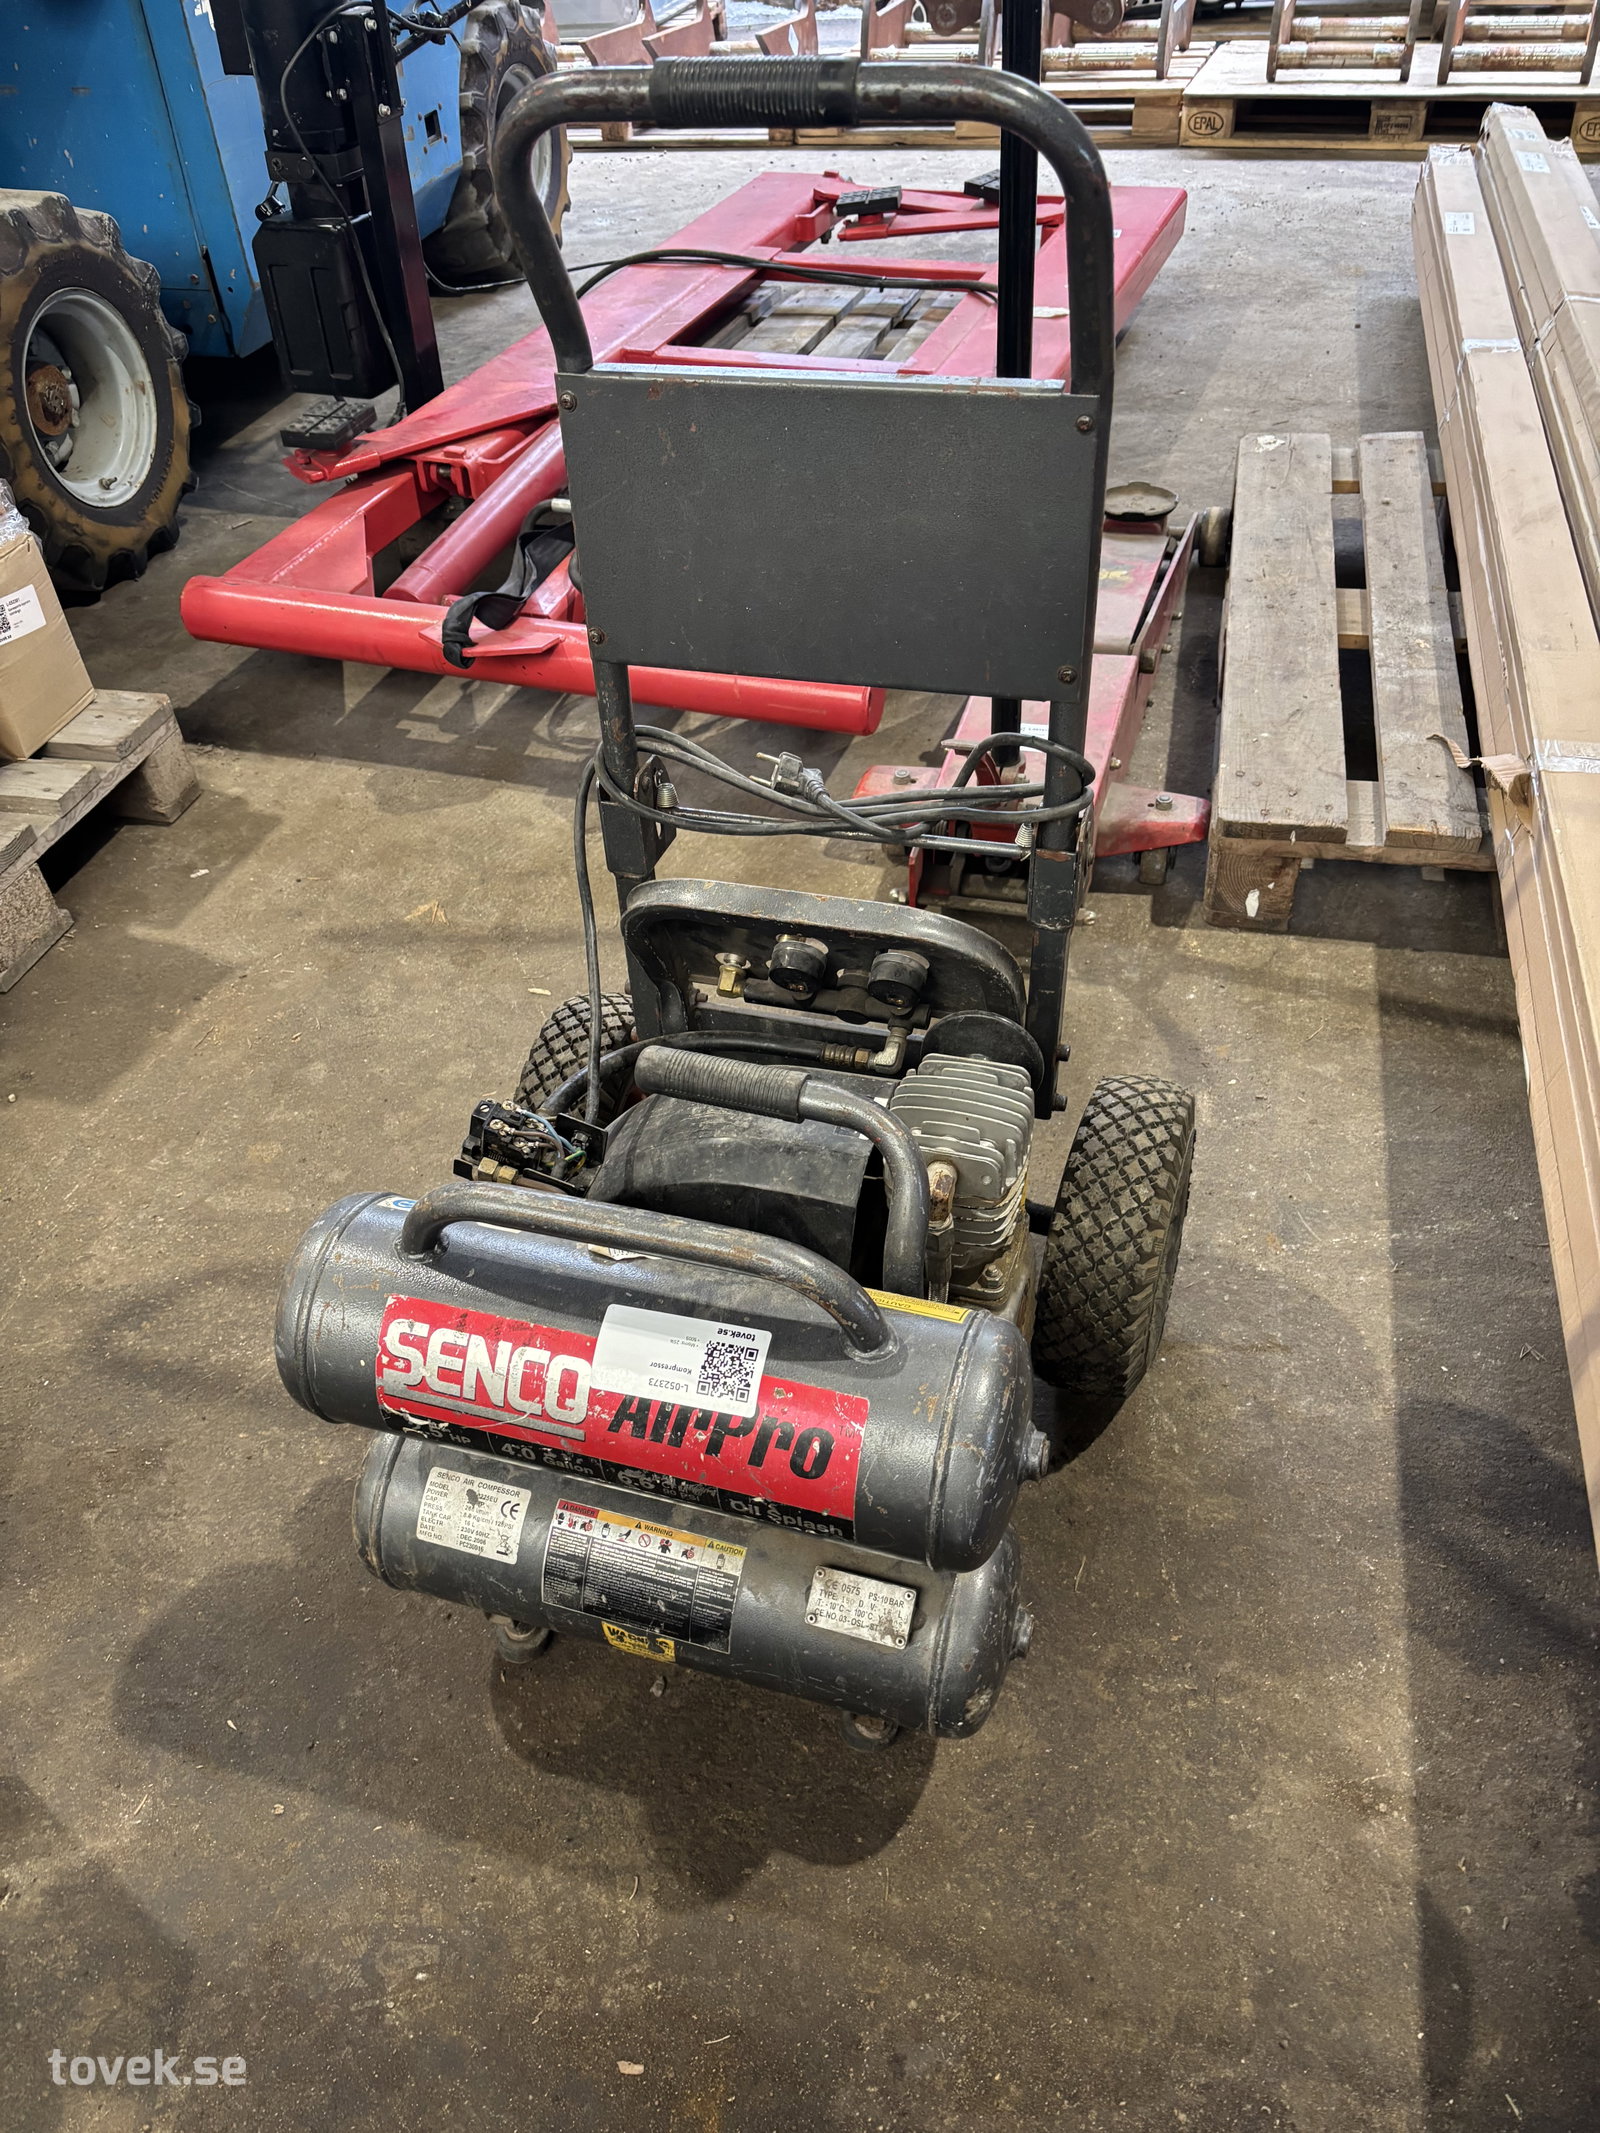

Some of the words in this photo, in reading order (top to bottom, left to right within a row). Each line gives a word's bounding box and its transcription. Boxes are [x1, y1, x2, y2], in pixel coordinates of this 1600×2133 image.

[1193, 116, 1217, 130] EPAL
[717, 1328, 755, 1342] tovek.se
[383, 1318, 593, 1424] SENCO
[650, 1362, 692, 1375] Kompressor
[648, 1378, 689, 1393] L-052373
[449, 1433, 471, 1444] HP
[607, 1395, 835, 1479] AirPro
[501, 1443, 536, 1460] 4.0
[543, 1456, 593, 1474] Gallon
[429, 1481, 450, 1491] MODEL
[437, 1471, 460, 1483] SENCO
[463, 1478, 475, 1486] AIR
[478, 1481, 520, 1498] COMPESSOR
[426, 1488, 449, 1498] POWER
[422, 1508, 438, 1518] TANK
[570, 1505, 595, 1516] DANGER
[729, 1500, 761, 1516] Oil
[767, 1508, 843, 1536] Splash
[420, 1523, 435, 1532] DATE
[644, 1524, 674, 1537] WARNING
[715, 1543, 744, 1556] CAUTION
[841, 1583, 861, 1595] 0575
